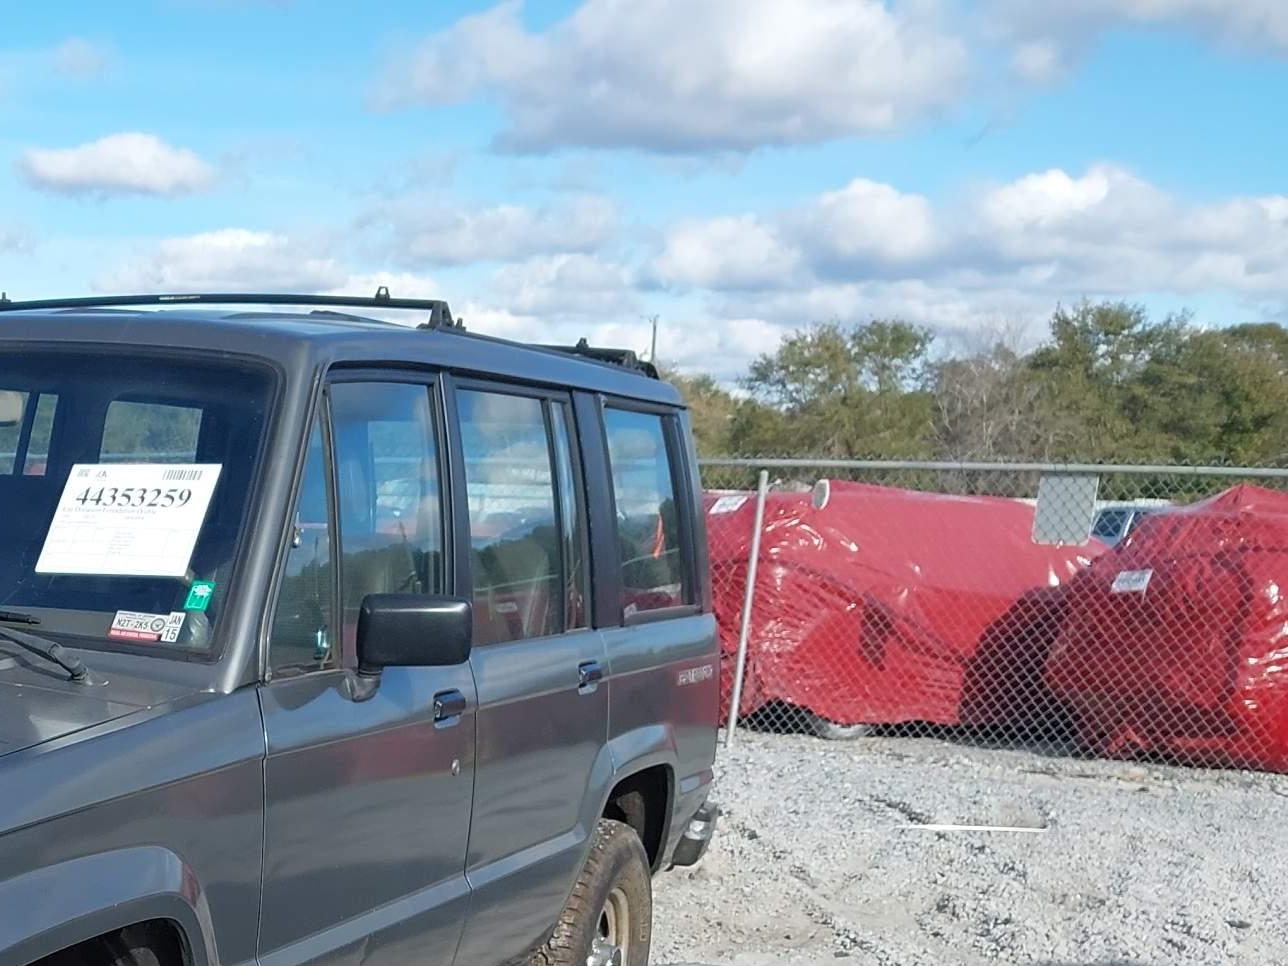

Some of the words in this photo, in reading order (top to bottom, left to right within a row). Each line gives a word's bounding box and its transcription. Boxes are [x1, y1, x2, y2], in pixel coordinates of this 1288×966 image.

[75, 486, 192, 508] 44353259
[169, 614, 183, 625] JAN
[165, 628, 178, 640] 15
